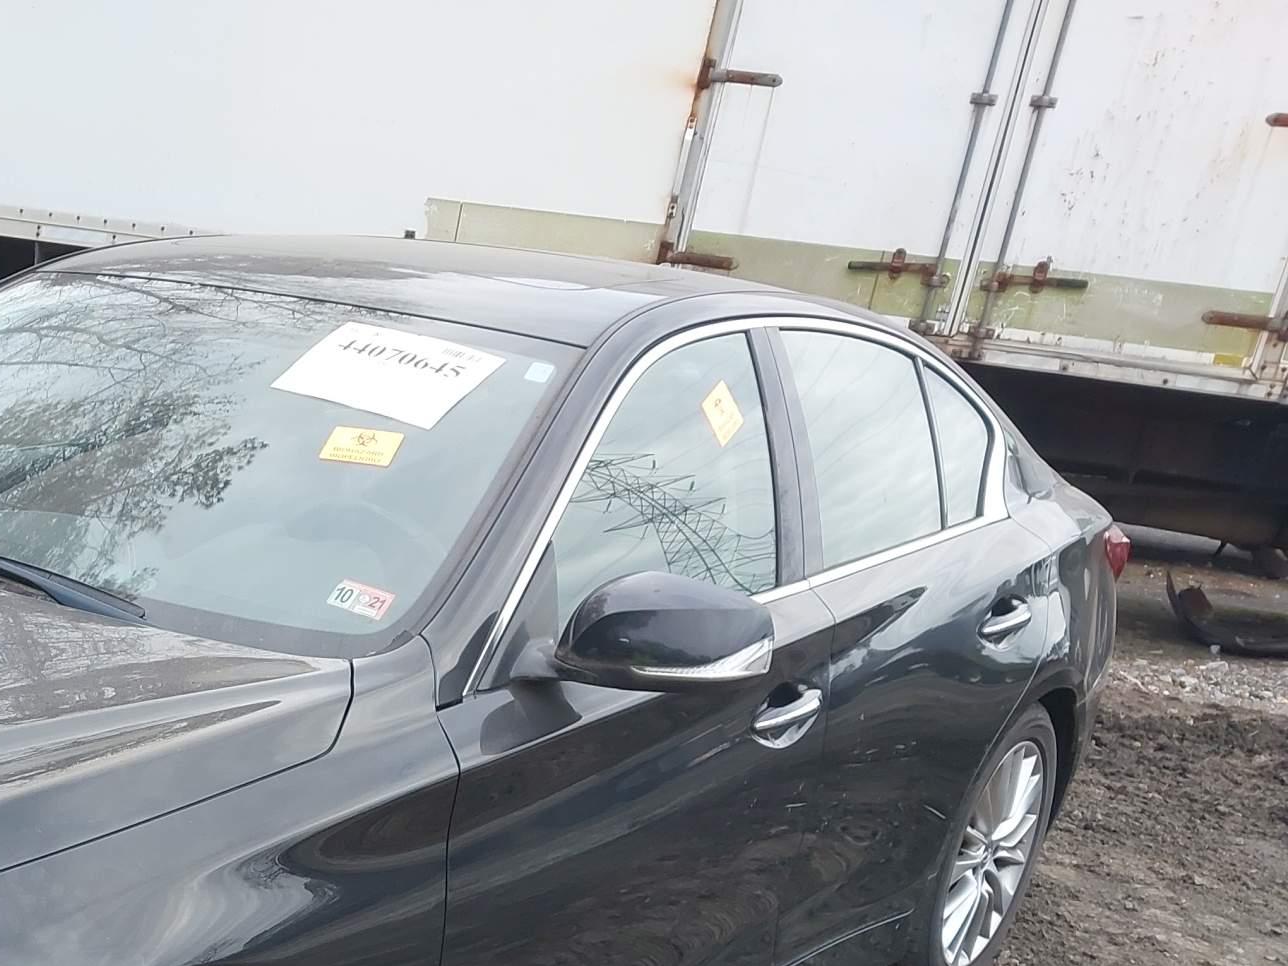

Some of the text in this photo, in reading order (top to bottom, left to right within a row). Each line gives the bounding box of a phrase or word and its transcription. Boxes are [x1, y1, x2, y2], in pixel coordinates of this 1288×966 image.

[338, 339, 466, 378] 44070645
[335, 586, 354, 604] 10
[368, 596, 387, 610] 21
